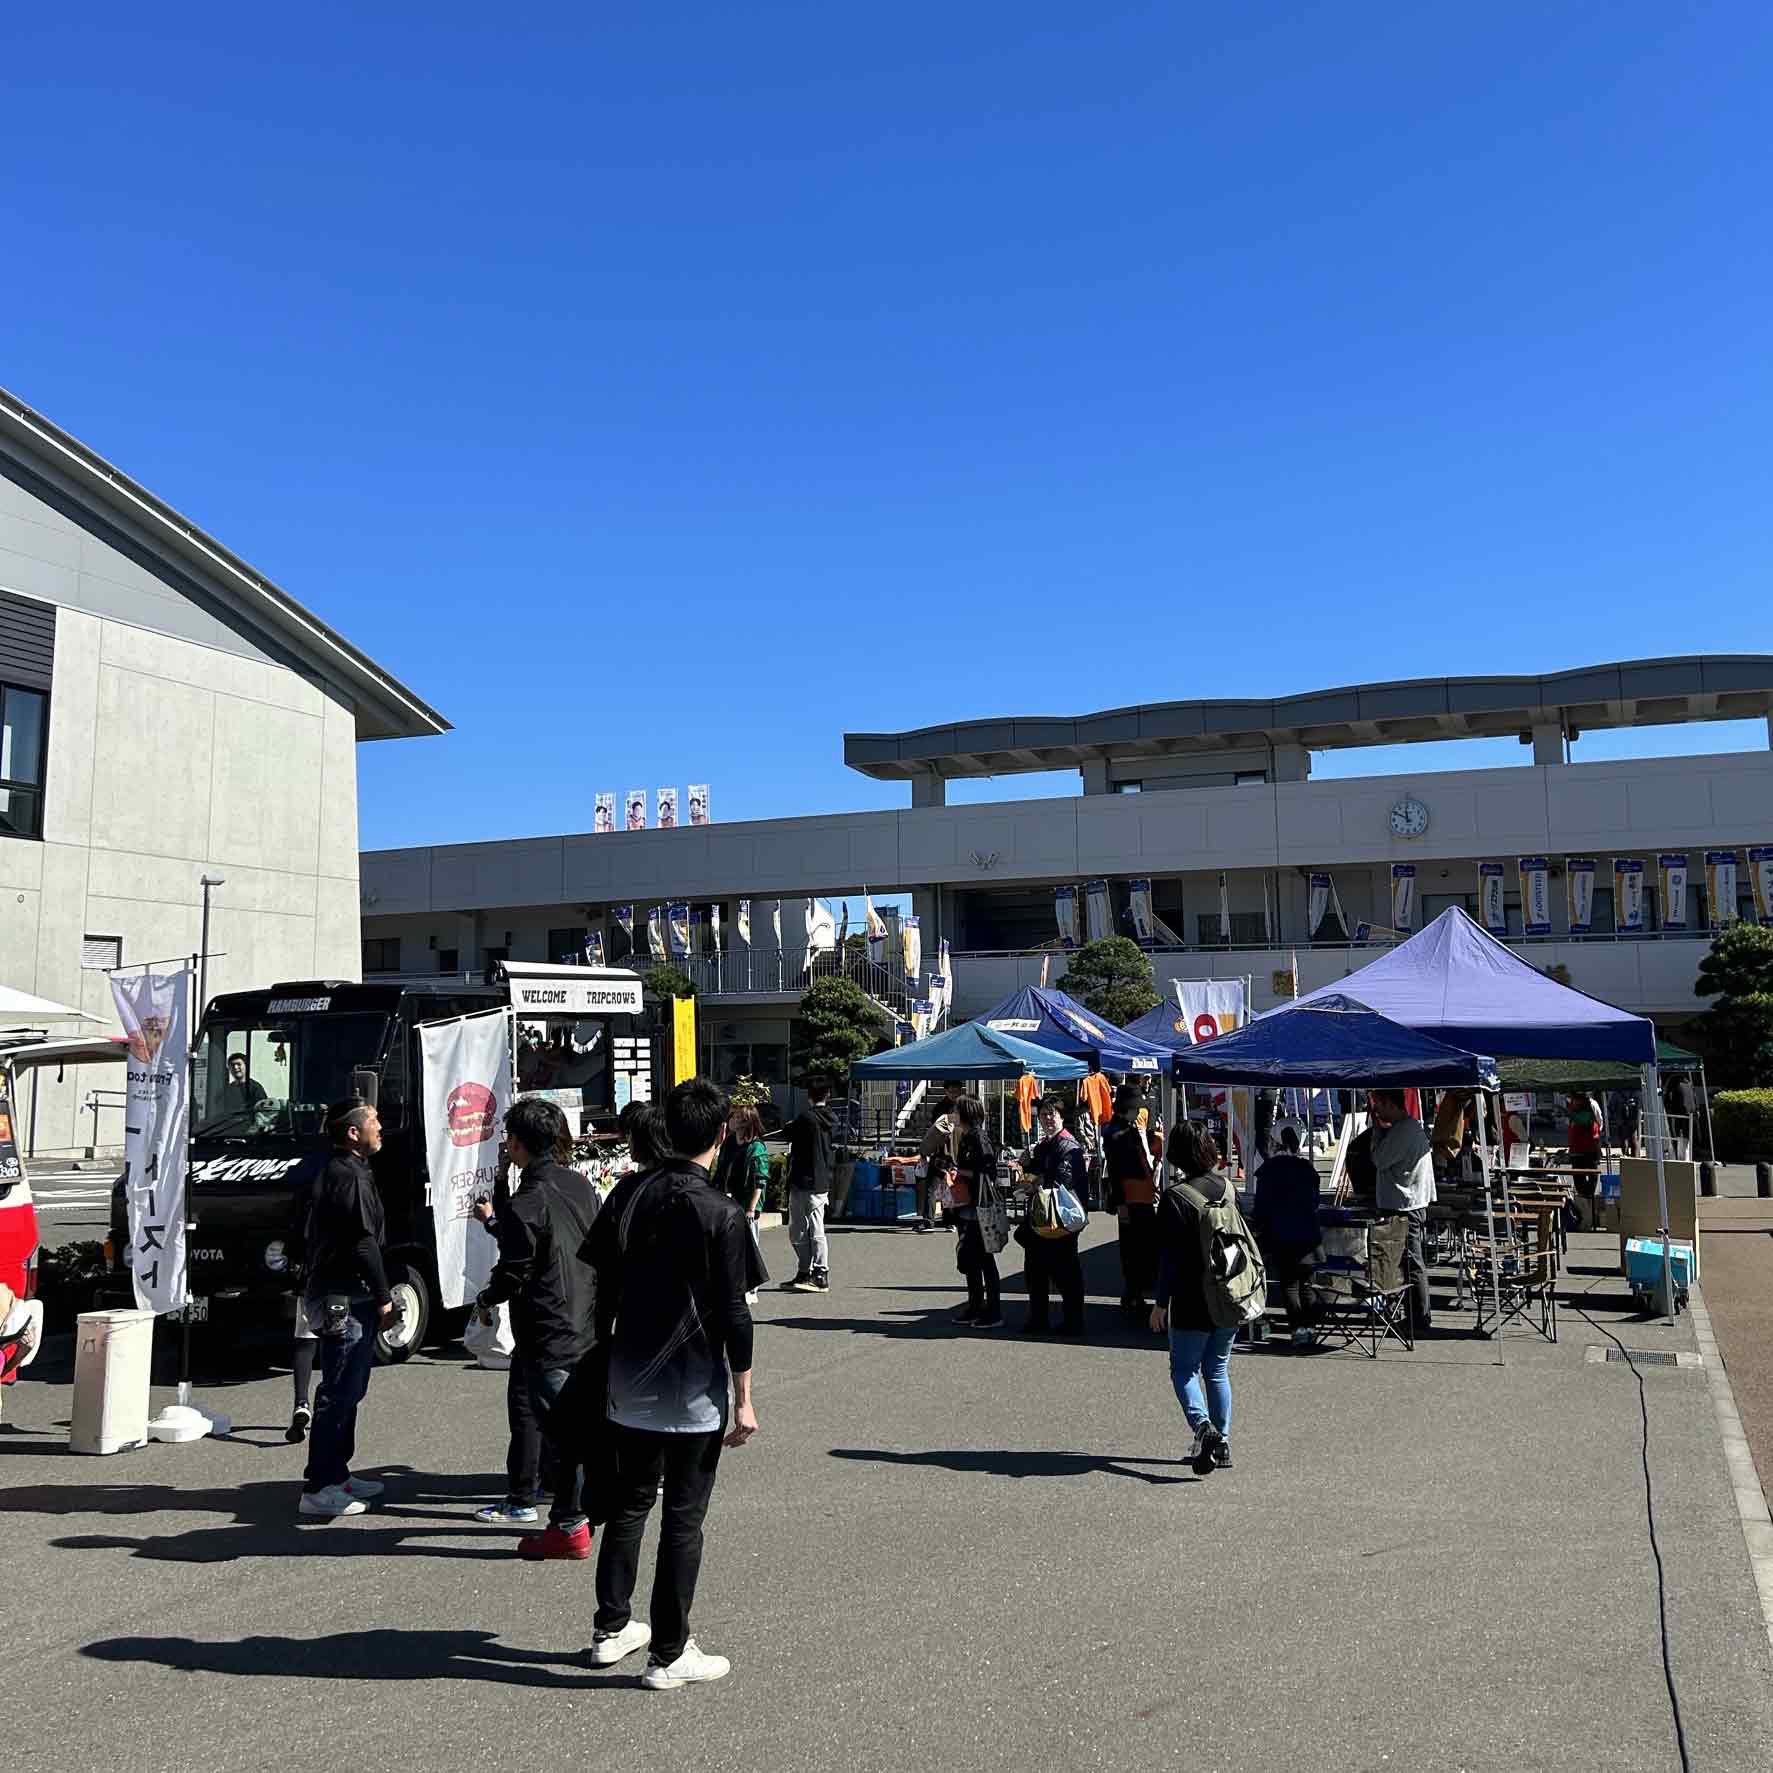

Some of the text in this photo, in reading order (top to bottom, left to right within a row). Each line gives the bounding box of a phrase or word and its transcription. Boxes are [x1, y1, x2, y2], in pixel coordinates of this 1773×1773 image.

[521, 989, 636, 1005] WELCOME TRIPCROWS
[266, 997, 331, 1014] HAMBURGER
[190, 1249, 224, 1260] YOTA
